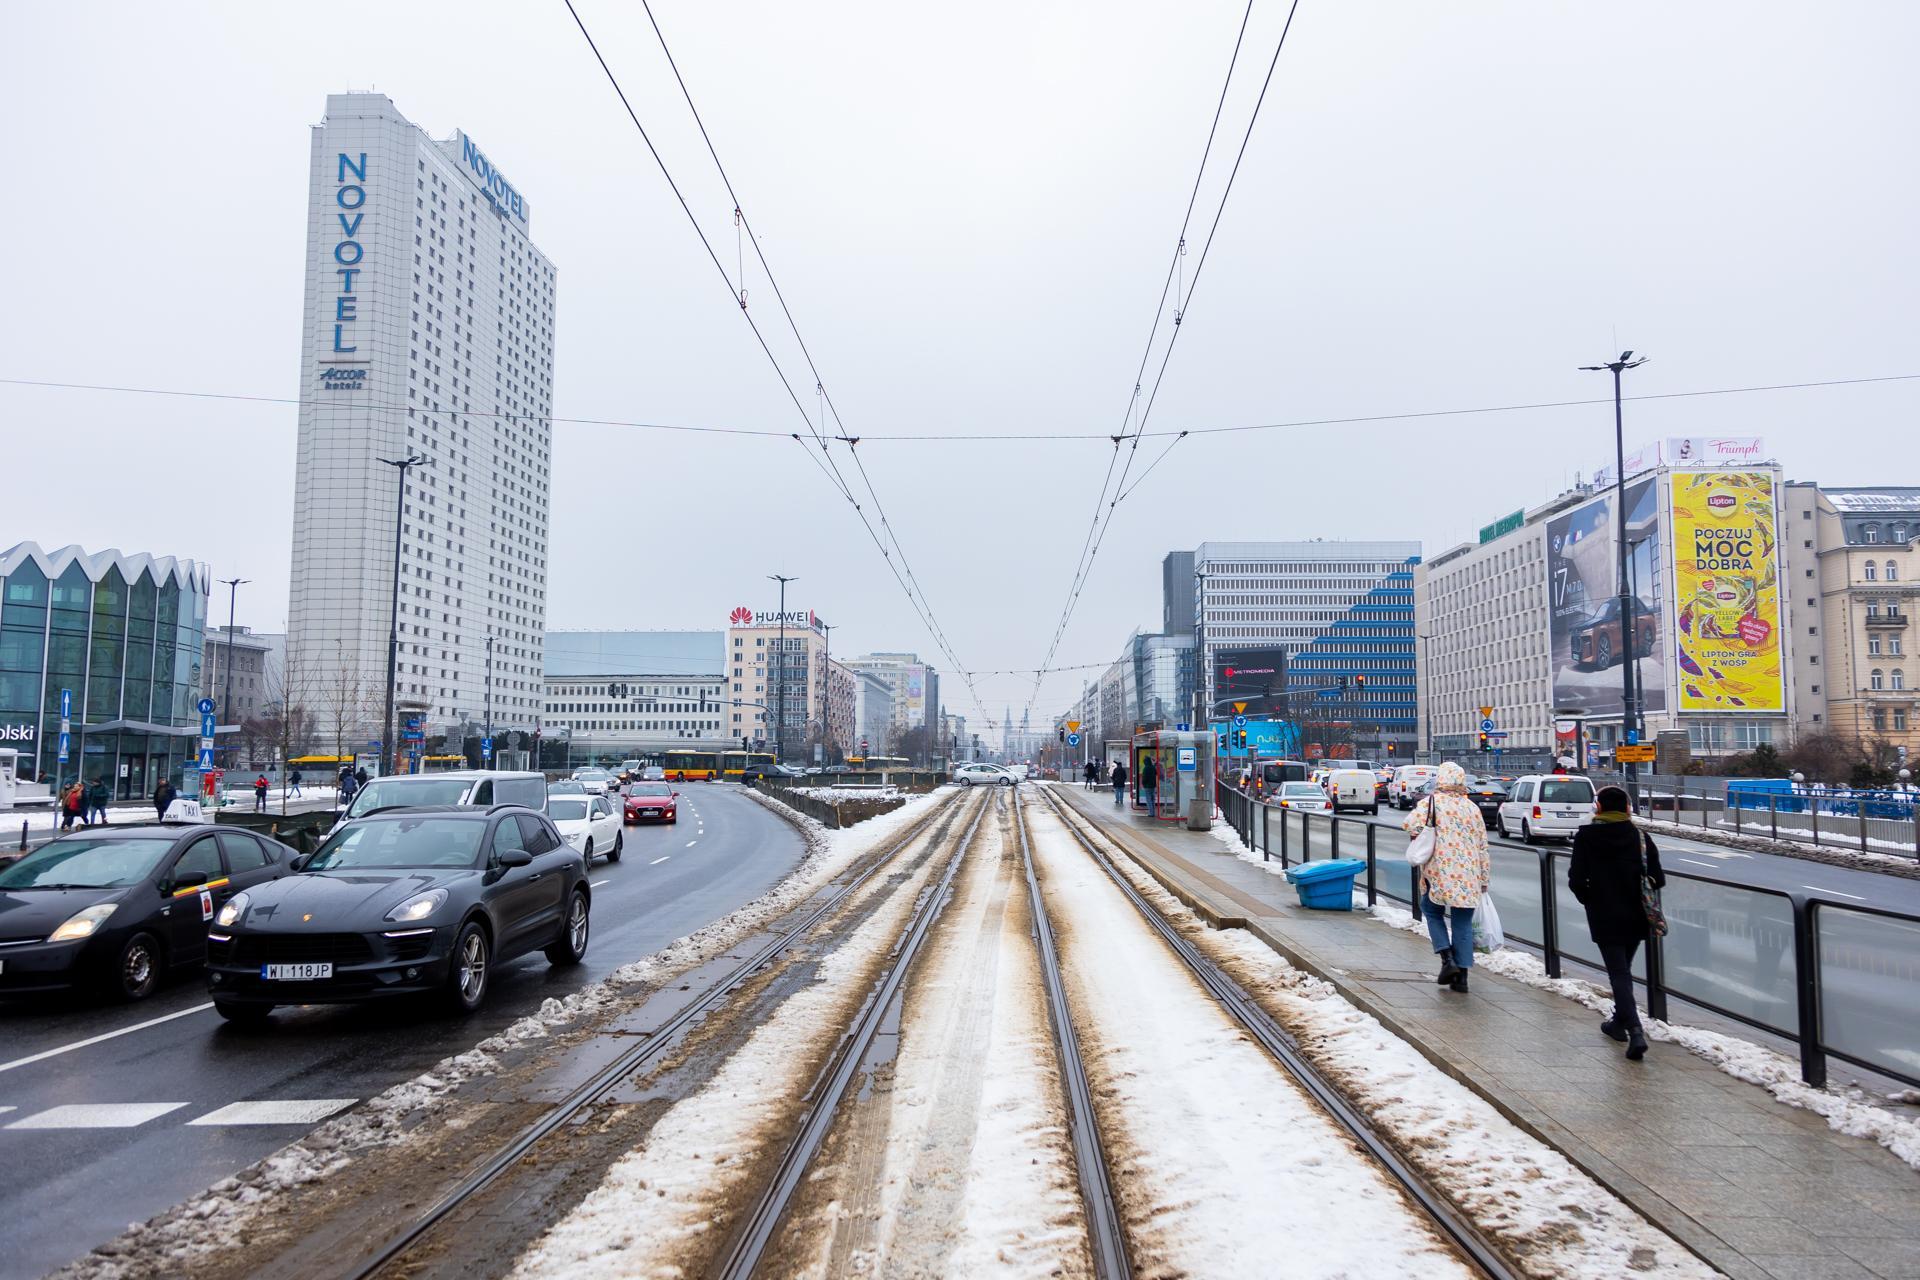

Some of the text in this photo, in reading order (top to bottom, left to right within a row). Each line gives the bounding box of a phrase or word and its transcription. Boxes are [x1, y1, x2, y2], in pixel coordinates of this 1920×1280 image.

[463, 133, 526, 223] NOVOTEL
[333, 152, 367, 353] NOVOTEL
[1708, 439, 1760, 458] Triumph
[1709, 497, 1735, 506] Lipton
[1695, 528, 1752, 539] POCZUJ
[1696, 540, 1753, 558] MOC
[1696, 559, 1753, 570] DOBRA
[1554, 567, 1568, 607] i7
[756, 612, 808, 622] HUAWEI
[183, 804, 199, 817] TAXI
[270, 964, 330, 978] WI 118JP
